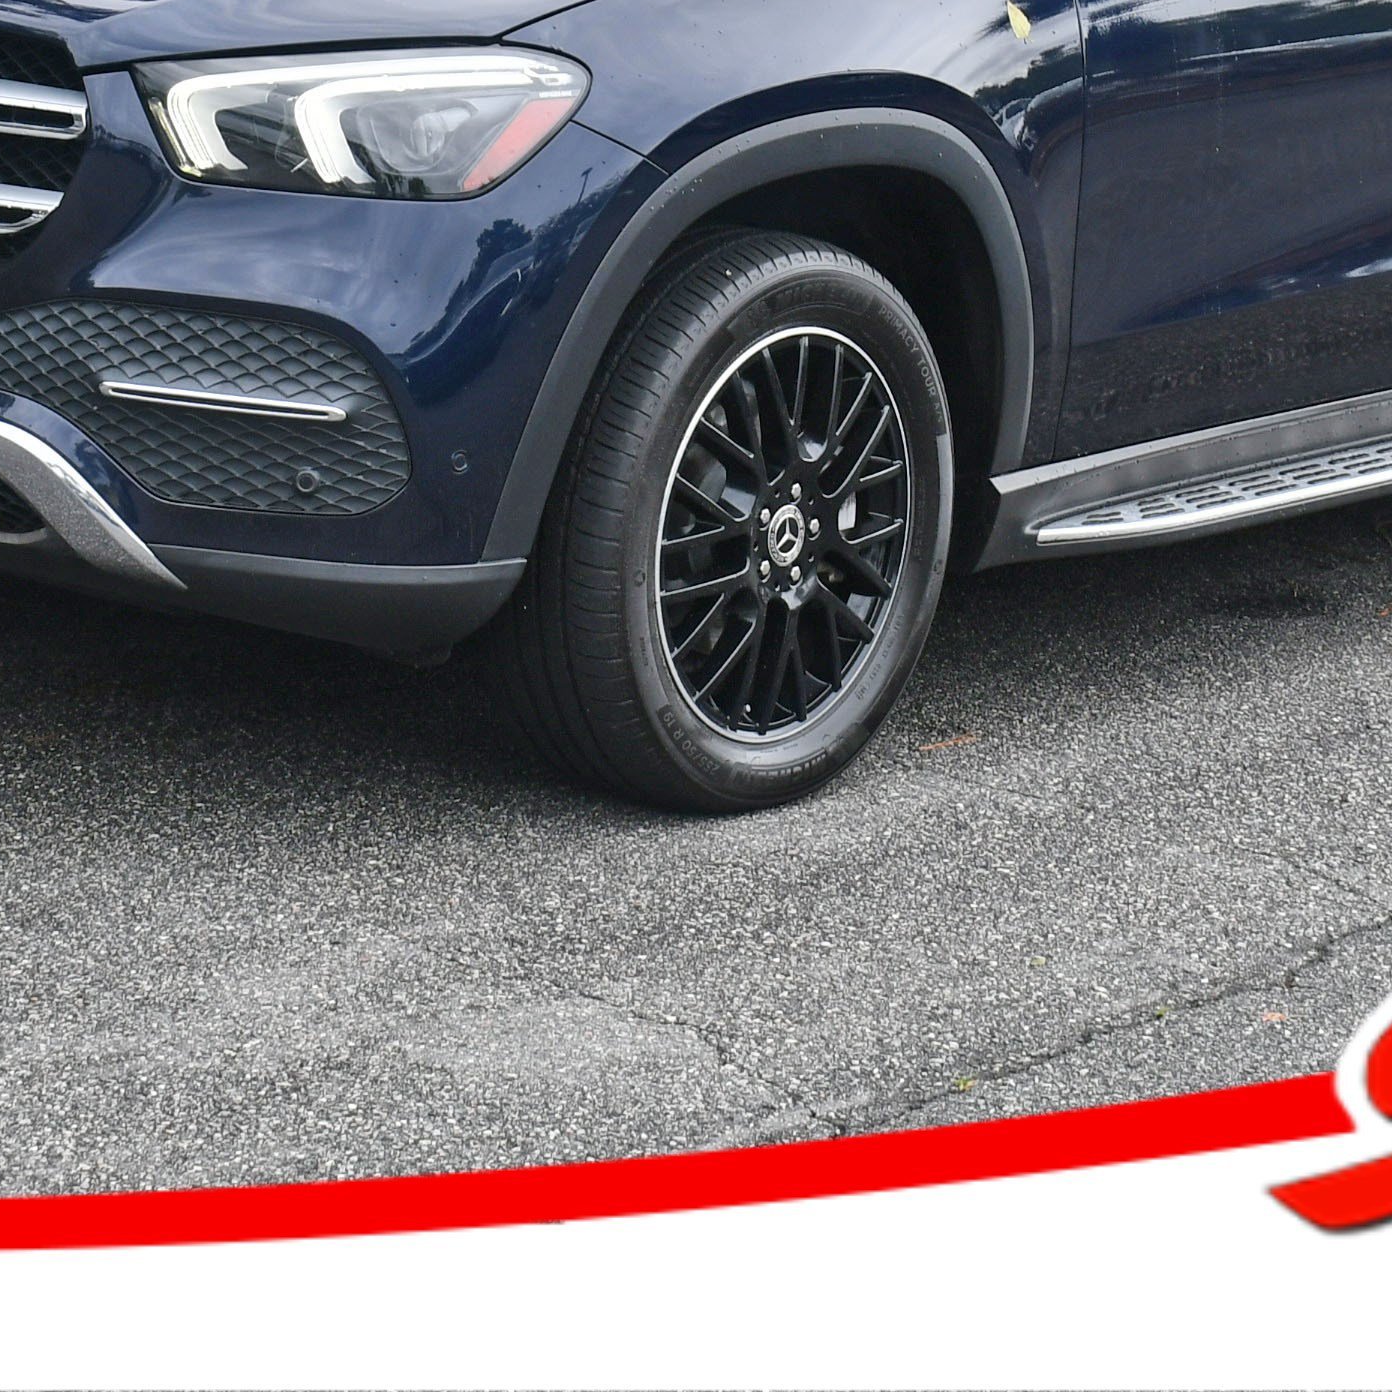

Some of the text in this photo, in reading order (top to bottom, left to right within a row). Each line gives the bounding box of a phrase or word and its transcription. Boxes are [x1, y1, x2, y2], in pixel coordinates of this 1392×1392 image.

[879, 306, 920, 354] PRIMACY
[917, 359, 937, 397] TOUR
[663, 711, 677, 730] 19
[673, 729, 685, 741] R
